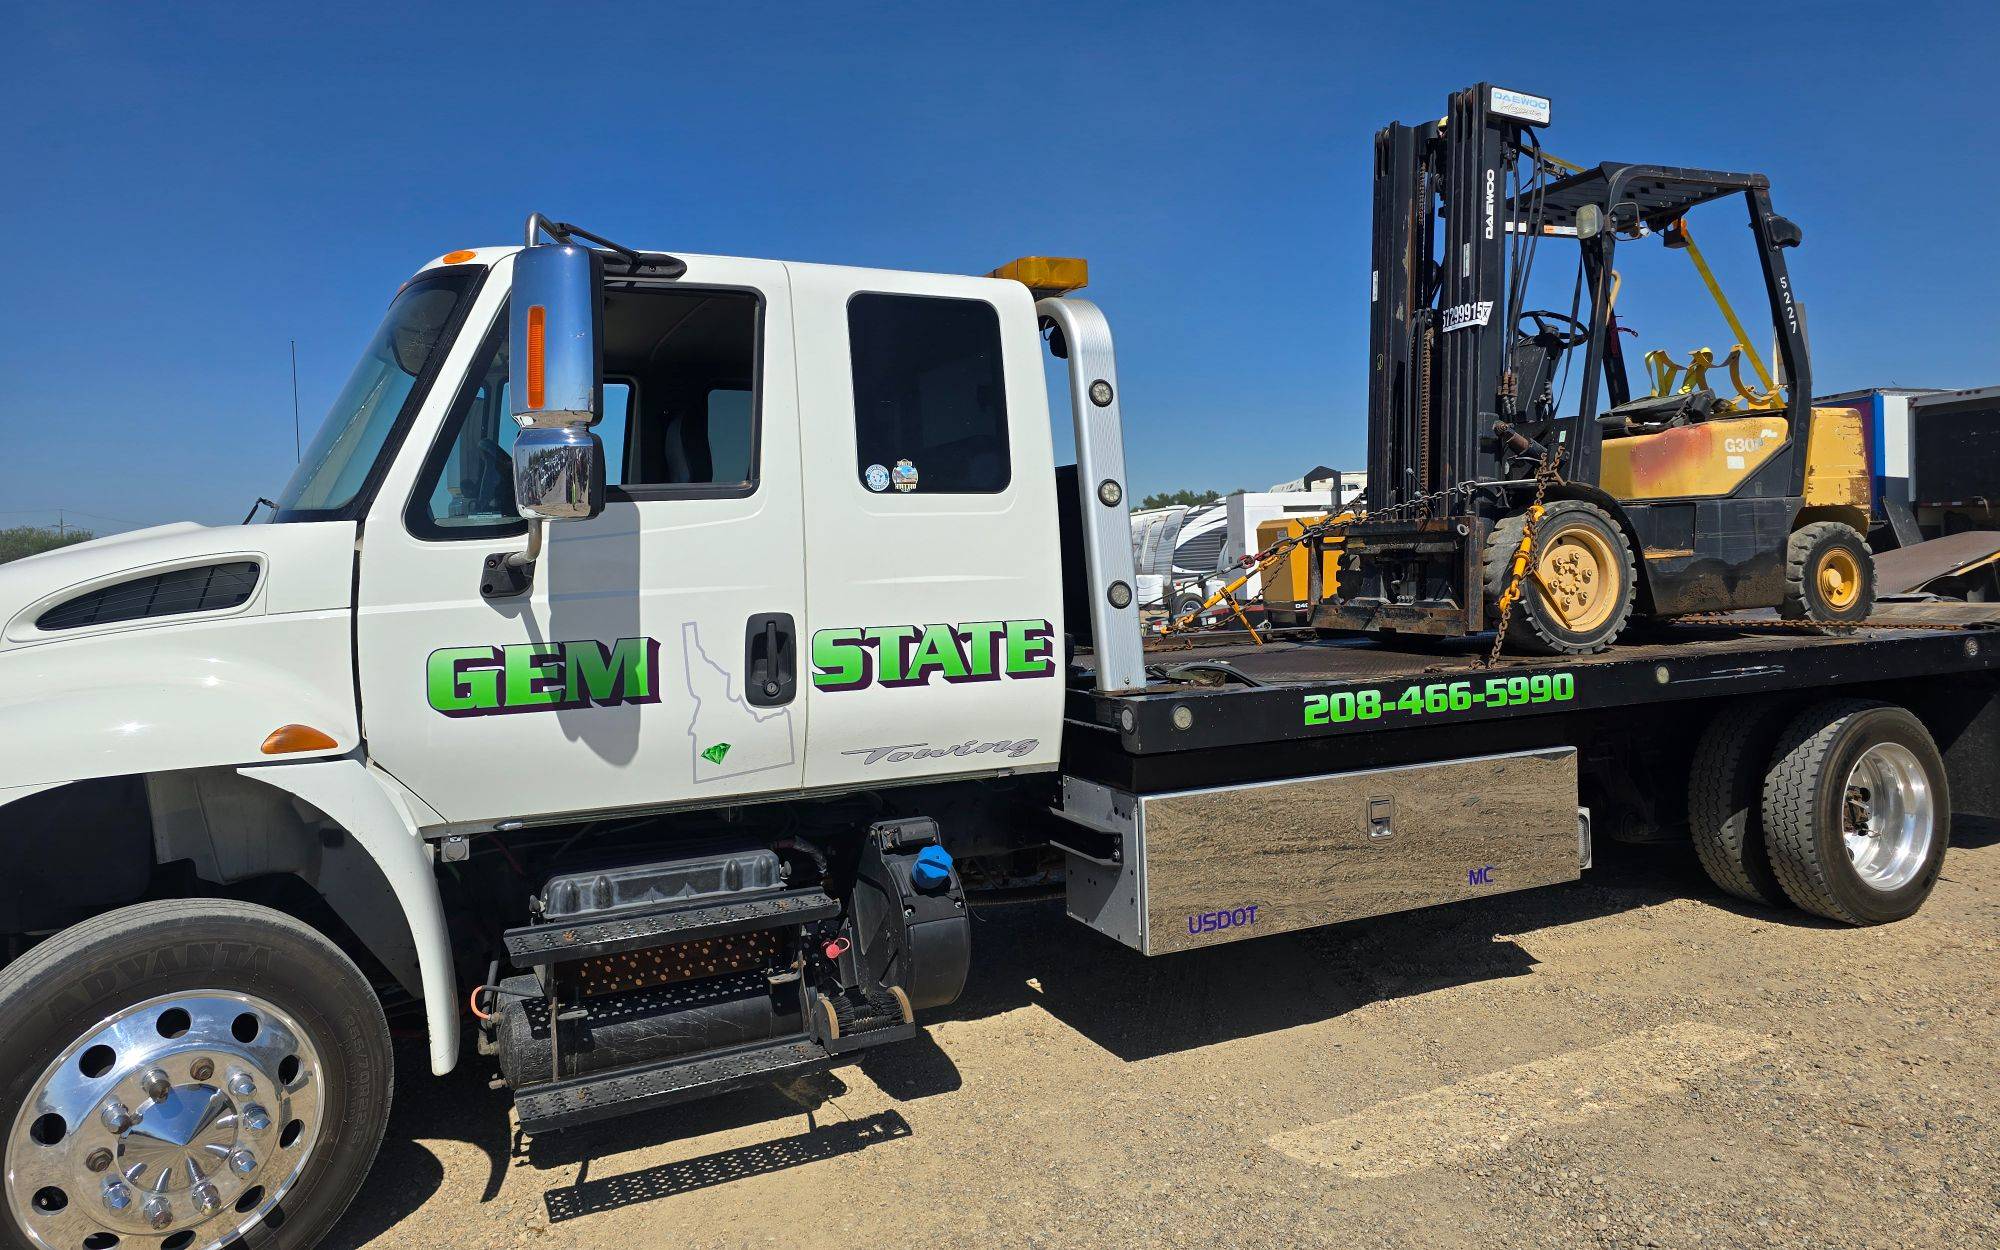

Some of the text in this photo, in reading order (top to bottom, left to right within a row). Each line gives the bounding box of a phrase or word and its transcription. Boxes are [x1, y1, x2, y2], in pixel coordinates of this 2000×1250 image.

[1493, 92, 1547, 110] DAEWOO
[1485, 168, 1495, 240] DAEWOO
[1779, 276, 1797, 334] 5227
[426, 619, 1056, 718] GEM STATE
[1303, 672, 1575, 726] 208-466-5990
[841, 738, 1040, 765] Towing
[1468, 864, 1495, 886] MC
[1188, 904, 1259, 934] USDOT
